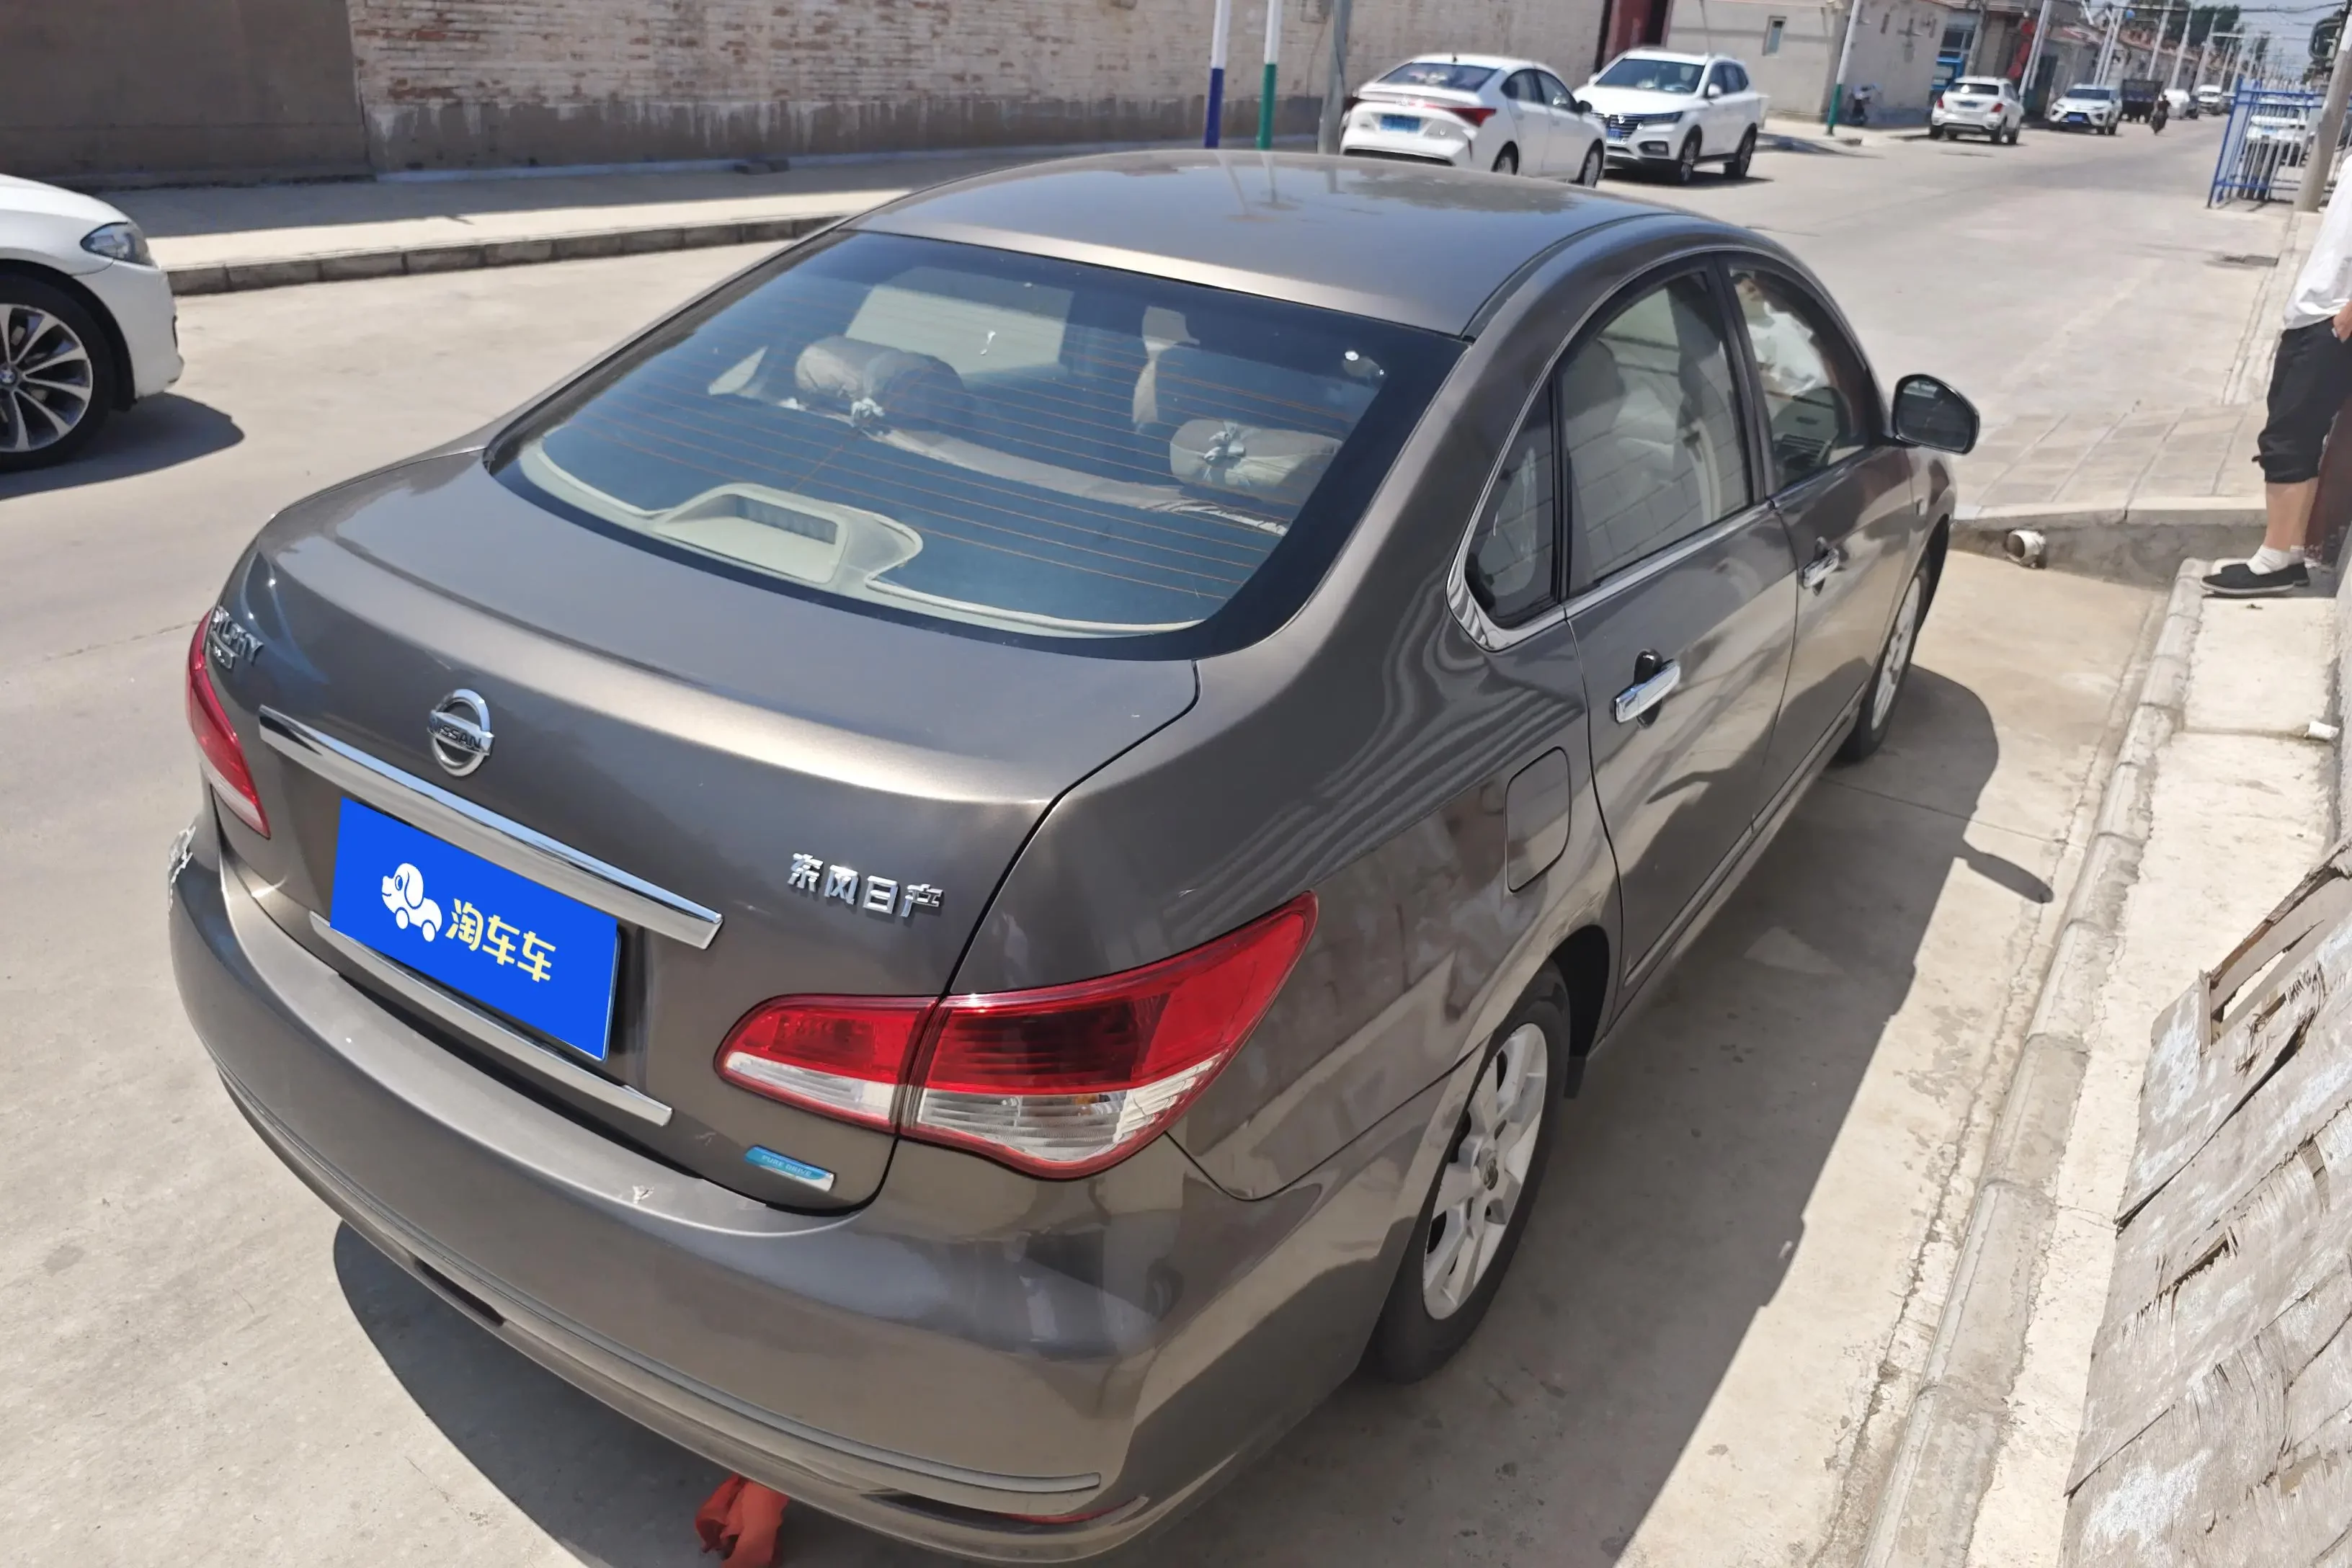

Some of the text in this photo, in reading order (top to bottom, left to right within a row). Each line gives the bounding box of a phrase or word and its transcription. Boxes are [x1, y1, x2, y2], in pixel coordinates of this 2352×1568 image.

[787, 852, 943, 917] 东风日产
[762, 1154, 812, 1176] PURE DRIVE
